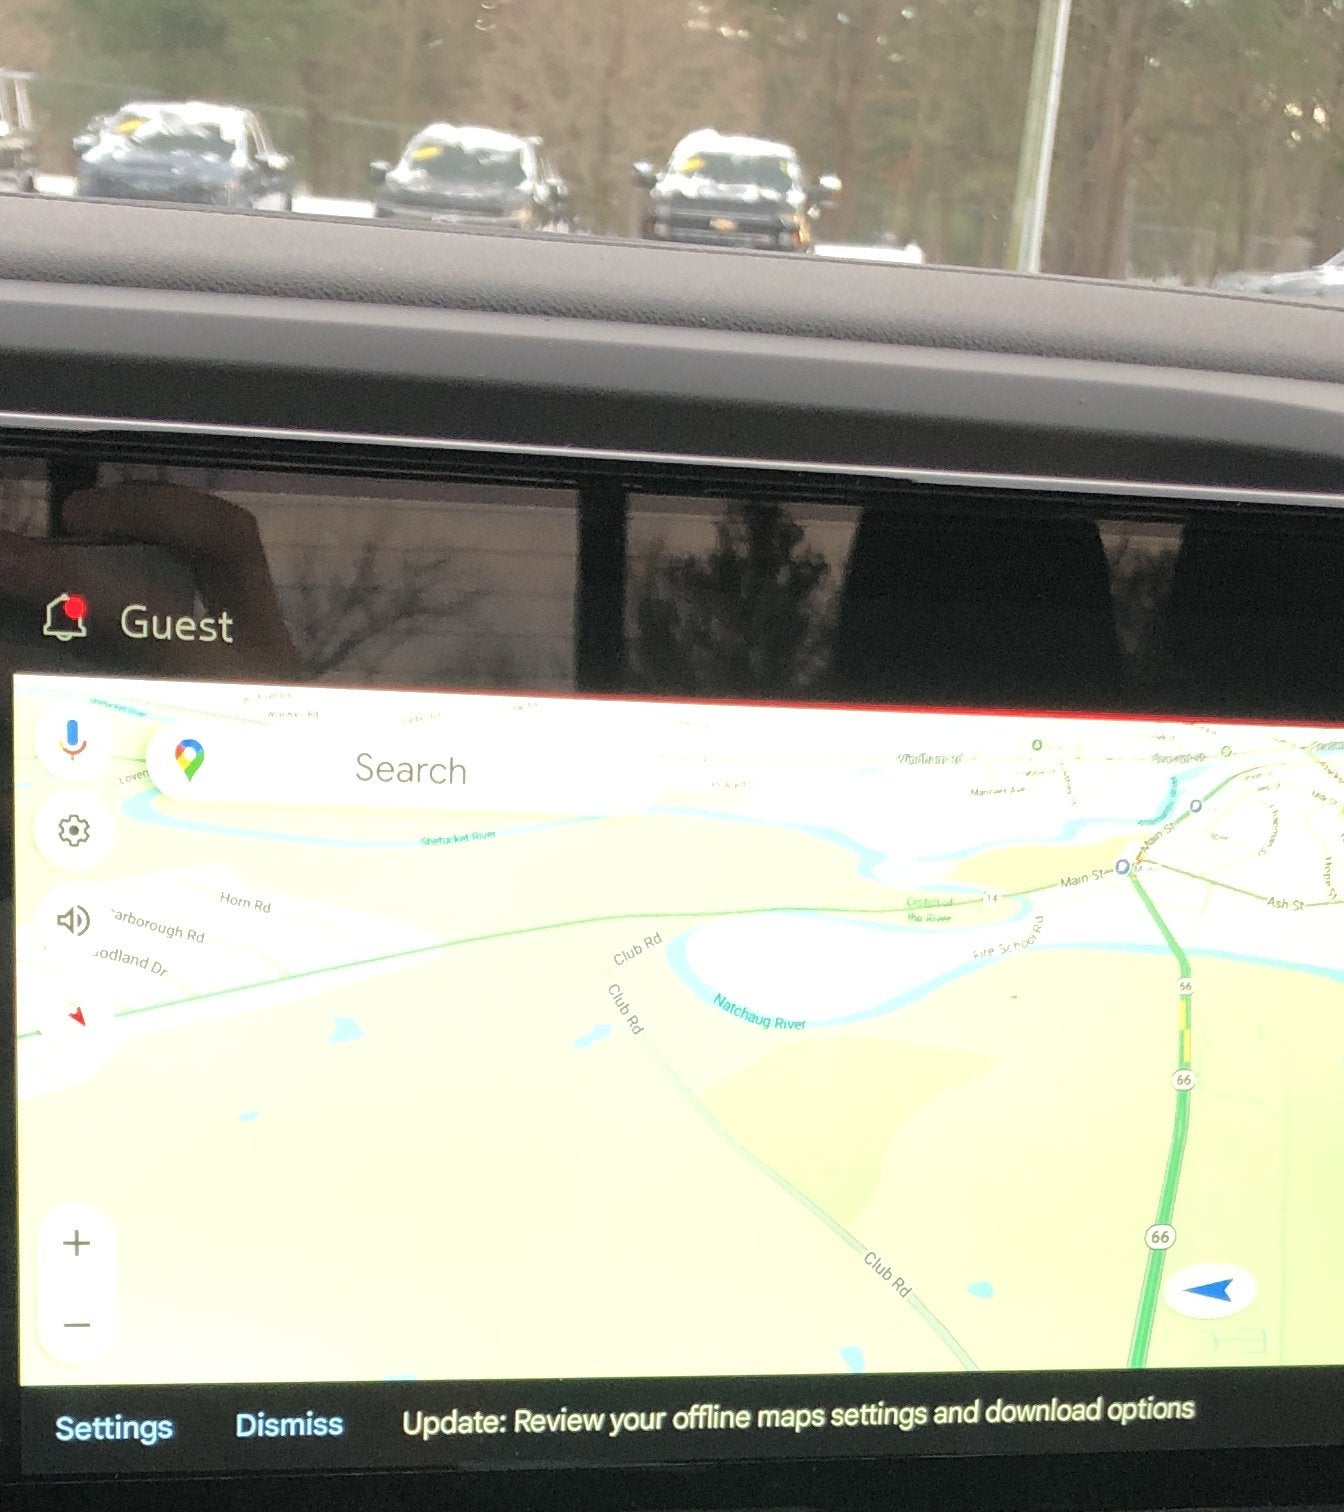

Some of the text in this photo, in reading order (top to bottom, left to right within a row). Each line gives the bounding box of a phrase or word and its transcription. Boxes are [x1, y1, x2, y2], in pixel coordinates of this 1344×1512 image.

[120, 604, 235, 645] Guest
[356, 752, 467, 785] Search
[472, 829, 497, 841] River
[1060, 876, 1089, 889] Main
[220, 891, 272, 914] Horn Rd
[1267, 896, 1305, 910] Ash St
[187, 929, 205, 944] Rd
[613, 931, 663, 967] Club Rd
[151, 961, 168, 977] Dr
[608, 983, 644, 1036] Club Rd
[713, 992, 806, 1030] Natchaug River
[1176, 1074, 1192, 1086] 66
[1150, 1230, 1170, 1245] 66
[864, 1251, 913, 1298] Club Rd
[55, 1413, 175, 1446] Settings
[236, 1410, 344, 1438] Dismiss
[402, 1395, 1196, 1440] Update: Review your offline maps settings and download options
